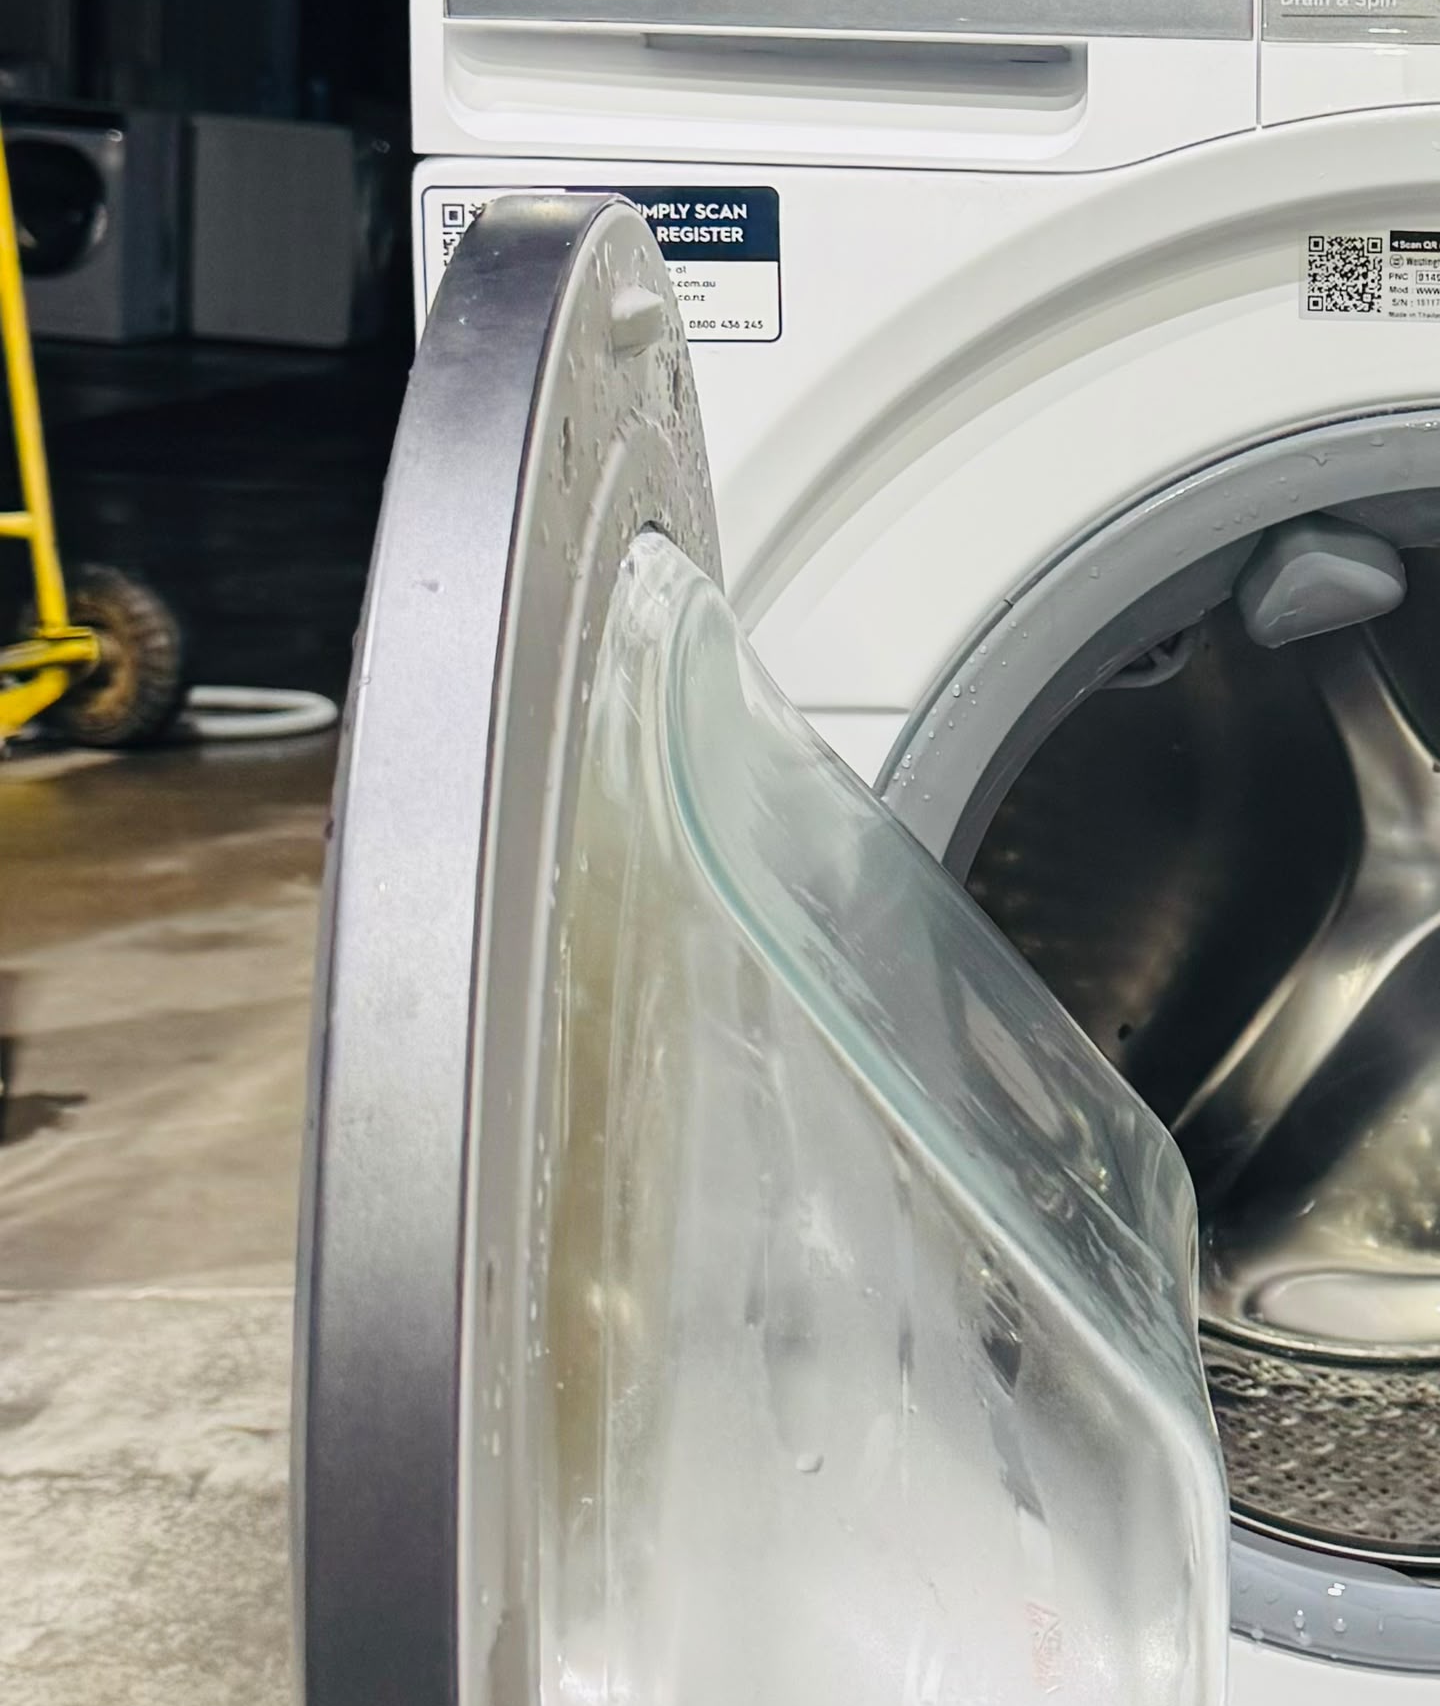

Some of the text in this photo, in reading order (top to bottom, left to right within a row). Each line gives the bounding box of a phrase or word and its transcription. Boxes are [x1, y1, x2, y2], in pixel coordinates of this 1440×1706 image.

[637, 203, 748, 220] IMPLY SCAN
[656, 226, 744, 243] REGISTER
[1400, 240, 1422, 250] Scan
[1423, 241, 1438, 251] QR
[1389, 272, 1409, 281] PNC
[689, 319, 717, 329] 0800
[744, 320, 764, 329] 245
